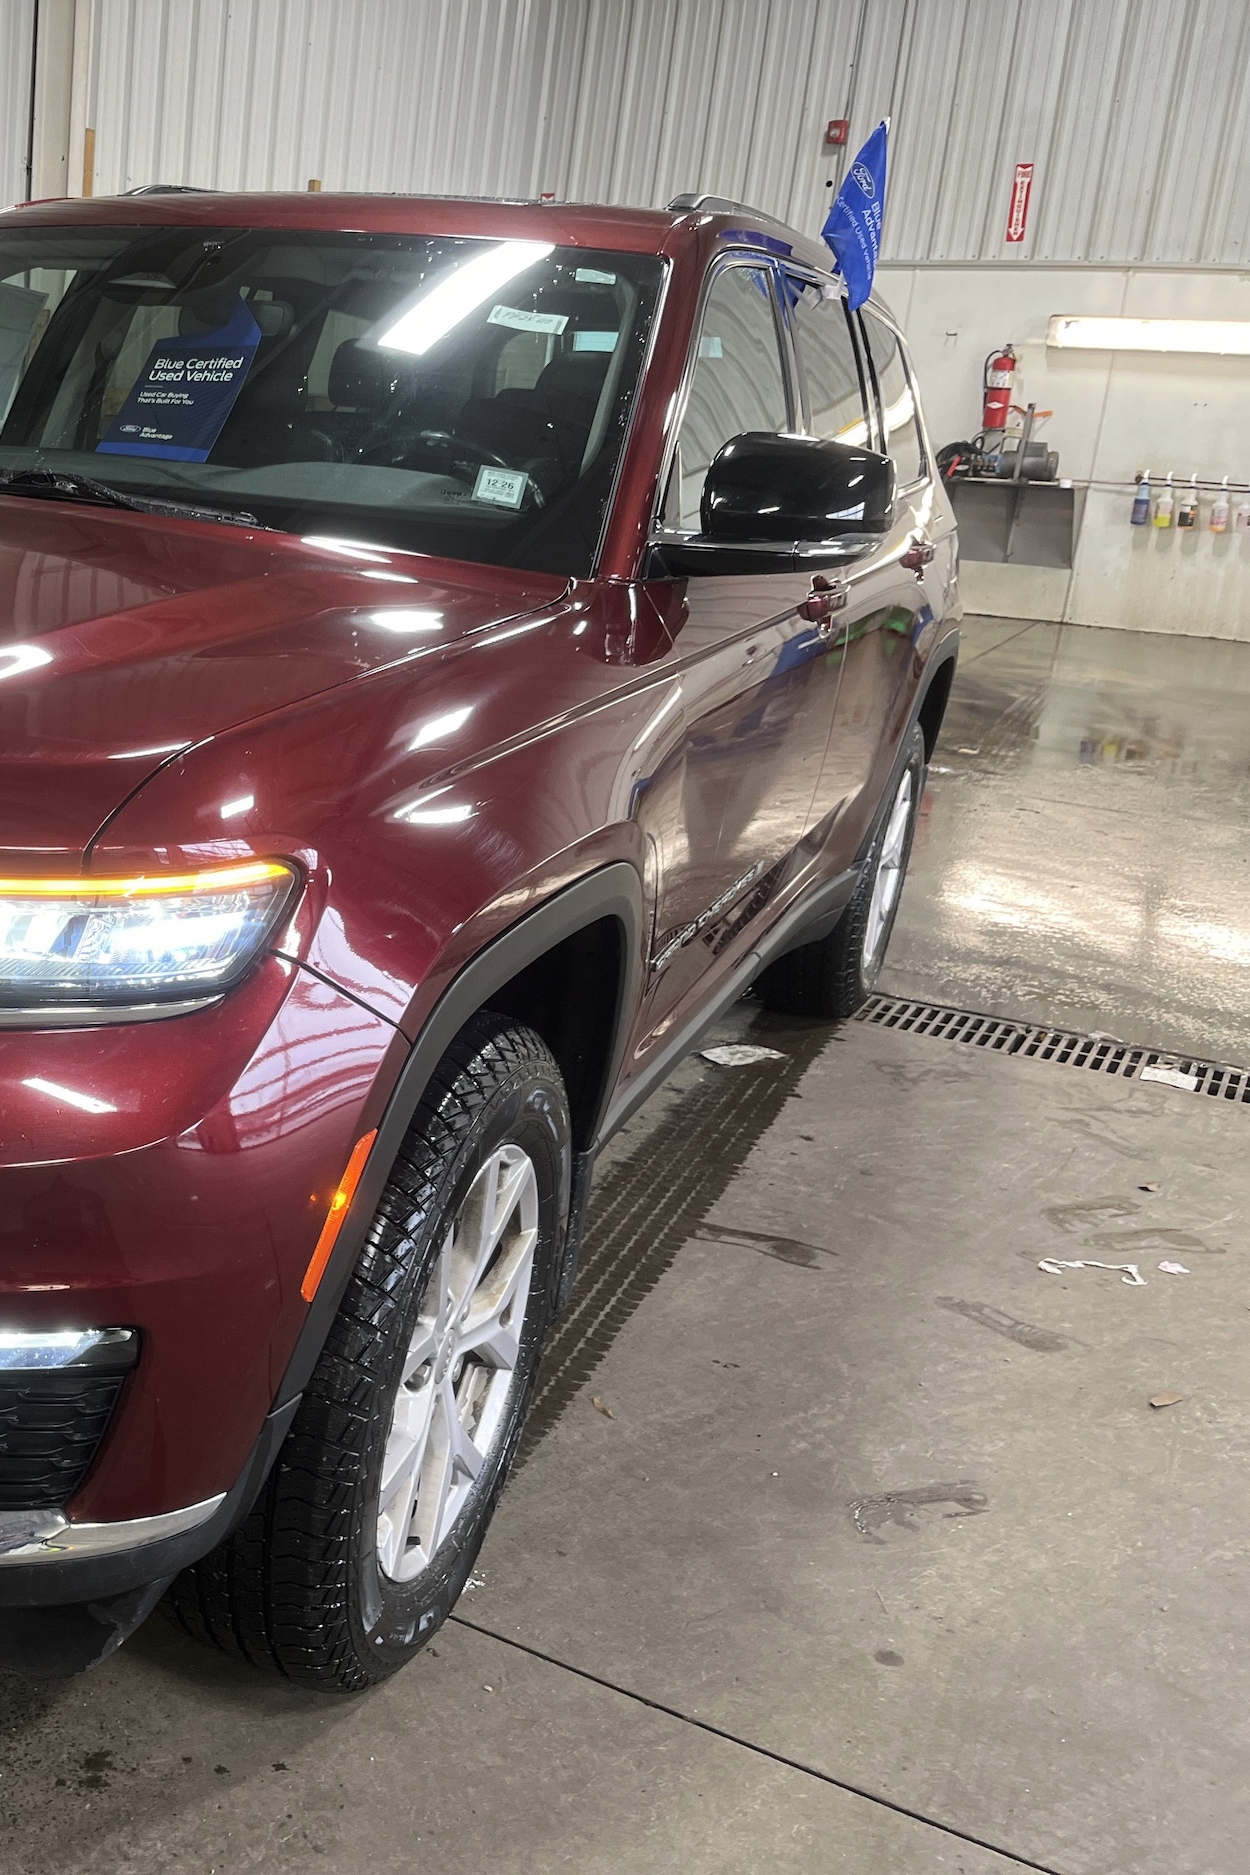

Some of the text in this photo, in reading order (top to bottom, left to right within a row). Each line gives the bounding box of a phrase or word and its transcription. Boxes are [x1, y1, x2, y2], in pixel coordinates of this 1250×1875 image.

[1017, 170, 1031, 178] FIRE
[871, 200, 882, 230] Blue
[836, 196, 860, 227] Certified
[855, 226, 868, 250] Used
[862, 208, 878, 267] Advanta
[154, 357, 244, 370] Blue Certified
[148, 370, 233, 382] Used Vehicle
[487, 479, 514, 490] 12 26
